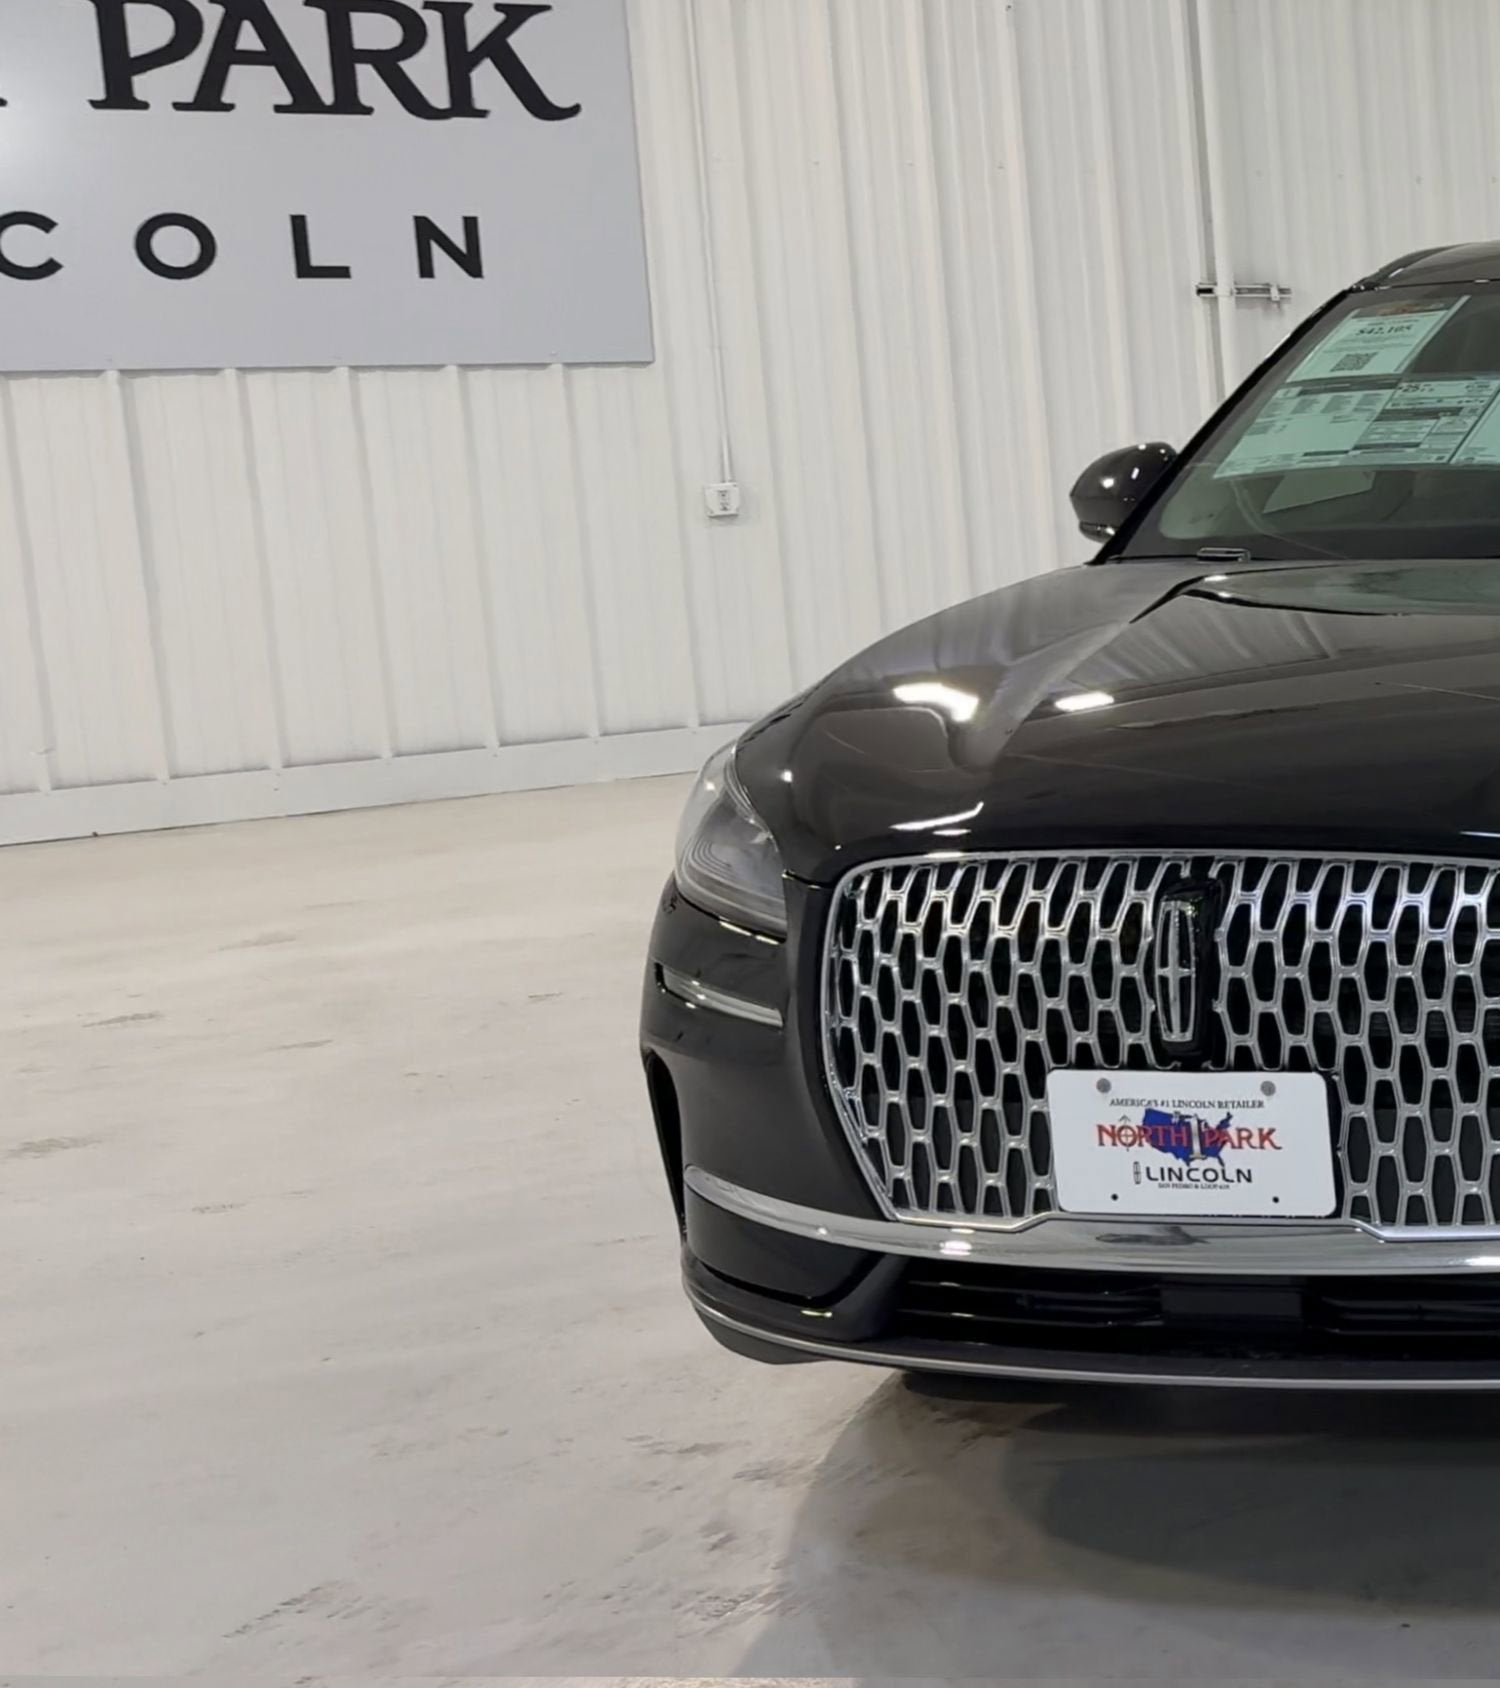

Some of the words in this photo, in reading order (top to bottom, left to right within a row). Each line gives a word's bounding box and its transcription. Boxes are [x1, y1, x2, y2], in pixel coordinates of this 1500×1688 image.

[88, 0, 582, 121] PARK
[1109, 1098, 1159, 1107] AMERICA'S
[1172, 1100, 1216, 1109] LINCOLN
[1217, 1100, 1265, 1109] RETAILER
[1096, 1124, 1189, 1147] NORTH
[1204, 1127, 1283, 1150] PARK
[1145, 1166, 1253, 1183] LINCOLN
